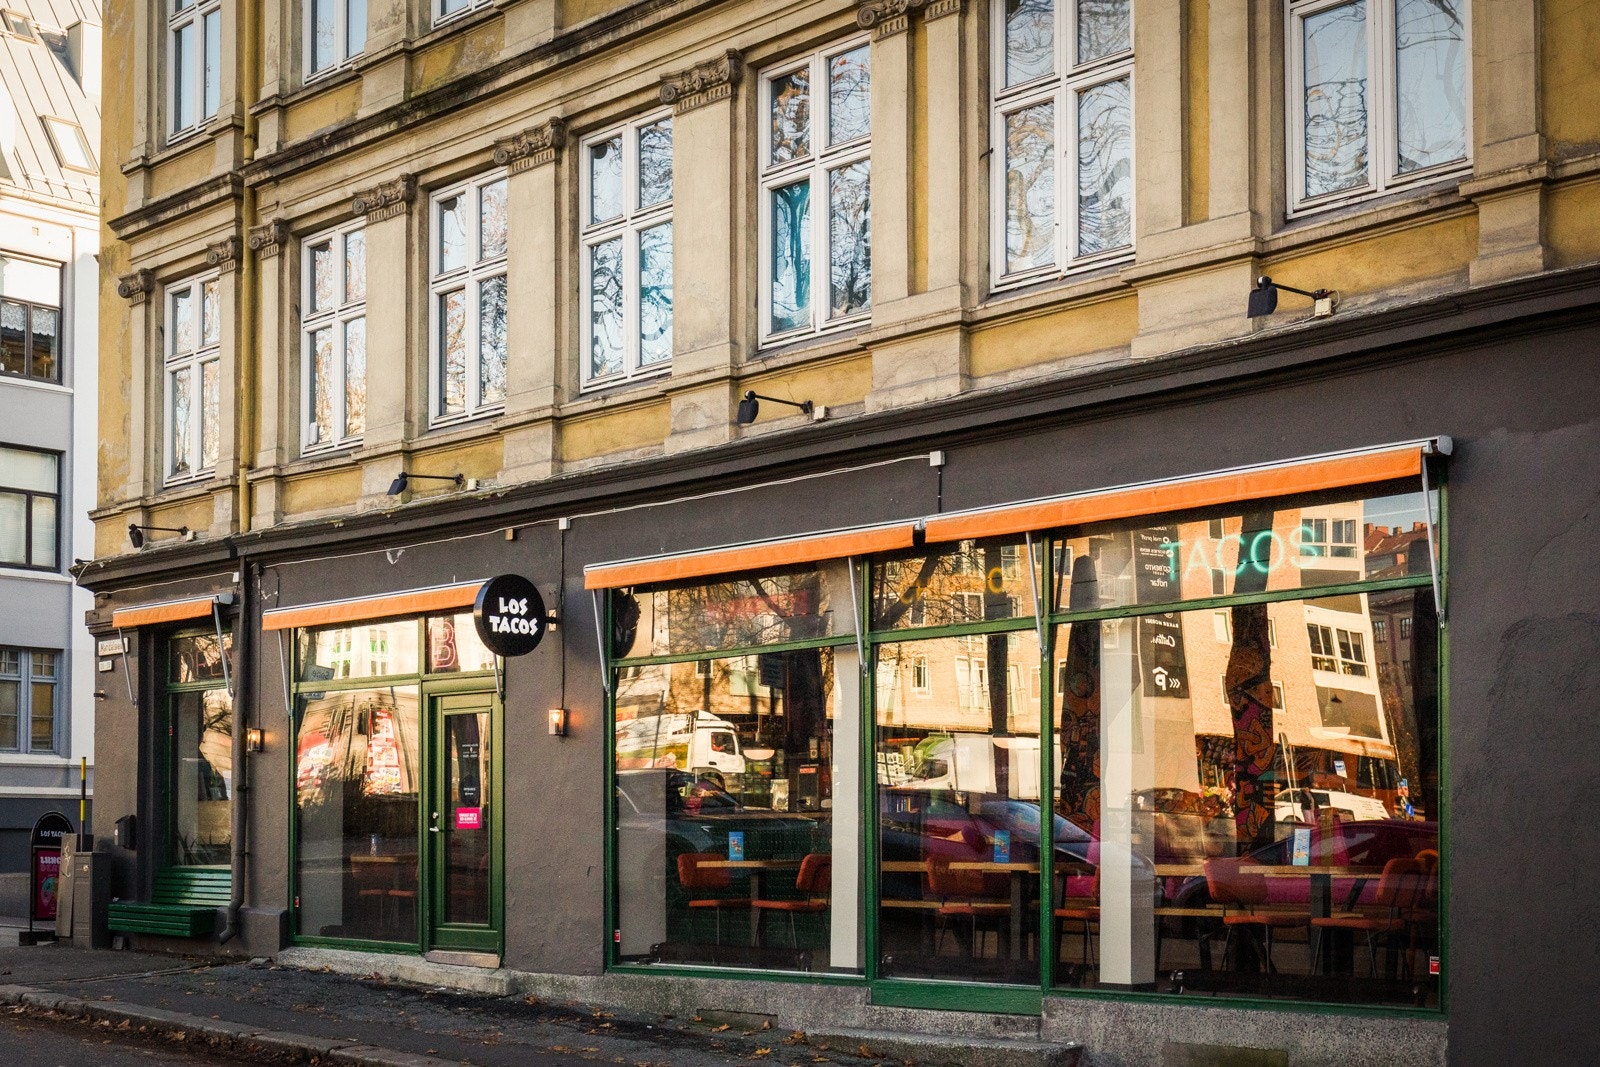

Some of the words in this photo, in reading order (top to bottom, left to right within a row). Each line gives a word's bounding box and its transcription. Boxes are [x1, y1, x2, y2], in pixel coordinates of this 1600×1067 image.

[1158, 525, 1318, 581] TACOS
[498, 596, 529, 616] LOS
[488, 615, 539, 637] TACOS
